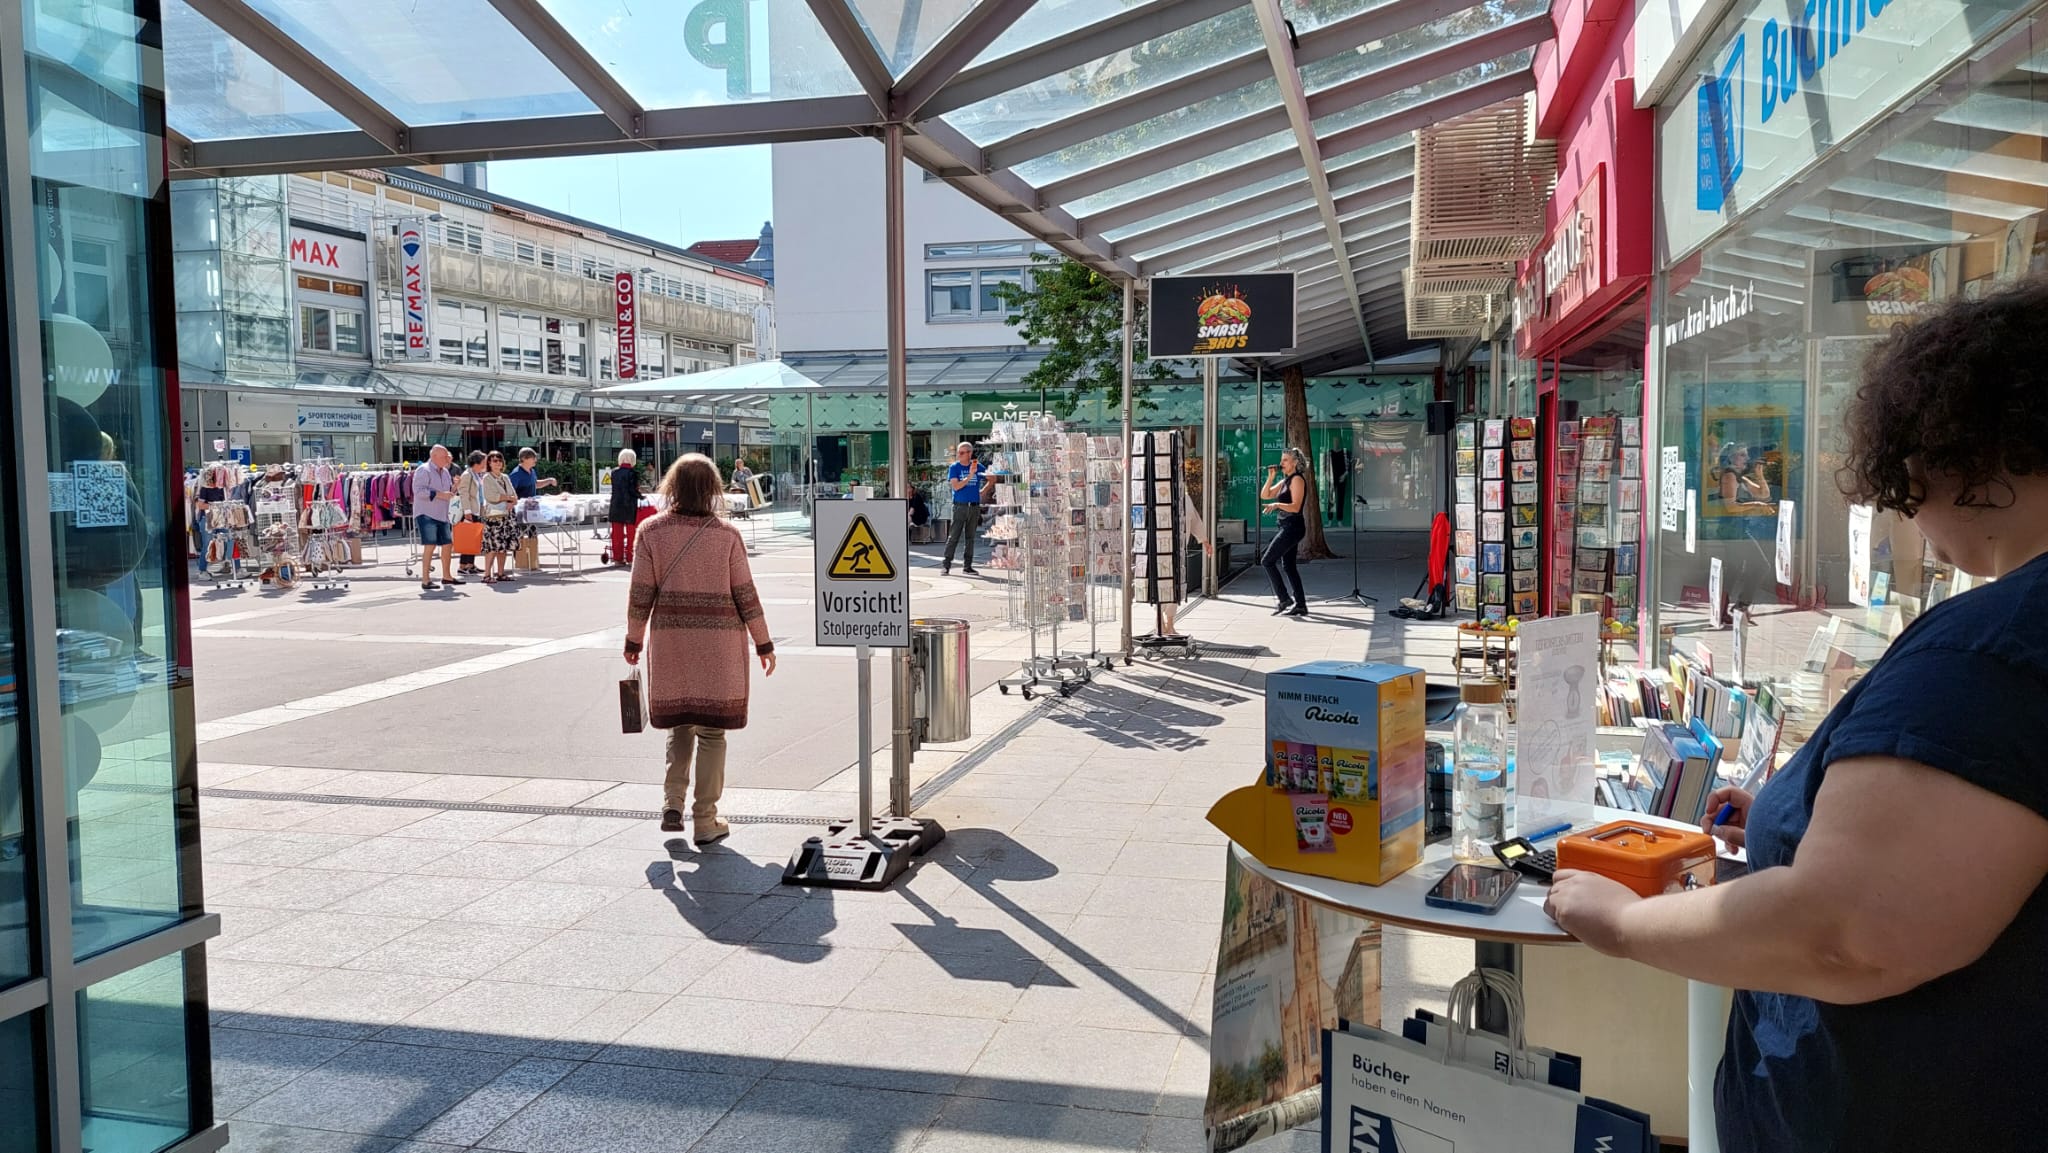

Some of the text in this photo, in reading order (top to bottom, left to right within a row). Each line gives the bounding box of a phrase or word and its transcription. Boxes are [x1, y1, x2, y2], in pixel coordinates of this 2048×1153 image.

[1544, 210, 1584, 298] TEEHAUS
[406, 264, 423, 348] RE/MAX
[618, 279, 633, 372] WEIN & CO
[1197, 323, 1249, 339] SMASH
[1208, 336, 1248, 350] BRO'S
[308, 412, 362, 421] SPORTORTHOPÄDIE
[822, 590, 903, 614] Vorsicht!
[823, 620, 902, 640] Stolpergefahr
[1277, 690, 1339, 706] NIMM EINFACH
[1304, 706, 1360, 725] Ricola
[1336, 759, 1366, 771] Ricola
[1296, 806, 1326, 816] Ricola
[1332, 812, 1348, 822] NEU
[1352, 1053, 1410, 1085] Bücher
[1351, 1073, 1466, 1125] haben einen Namen
